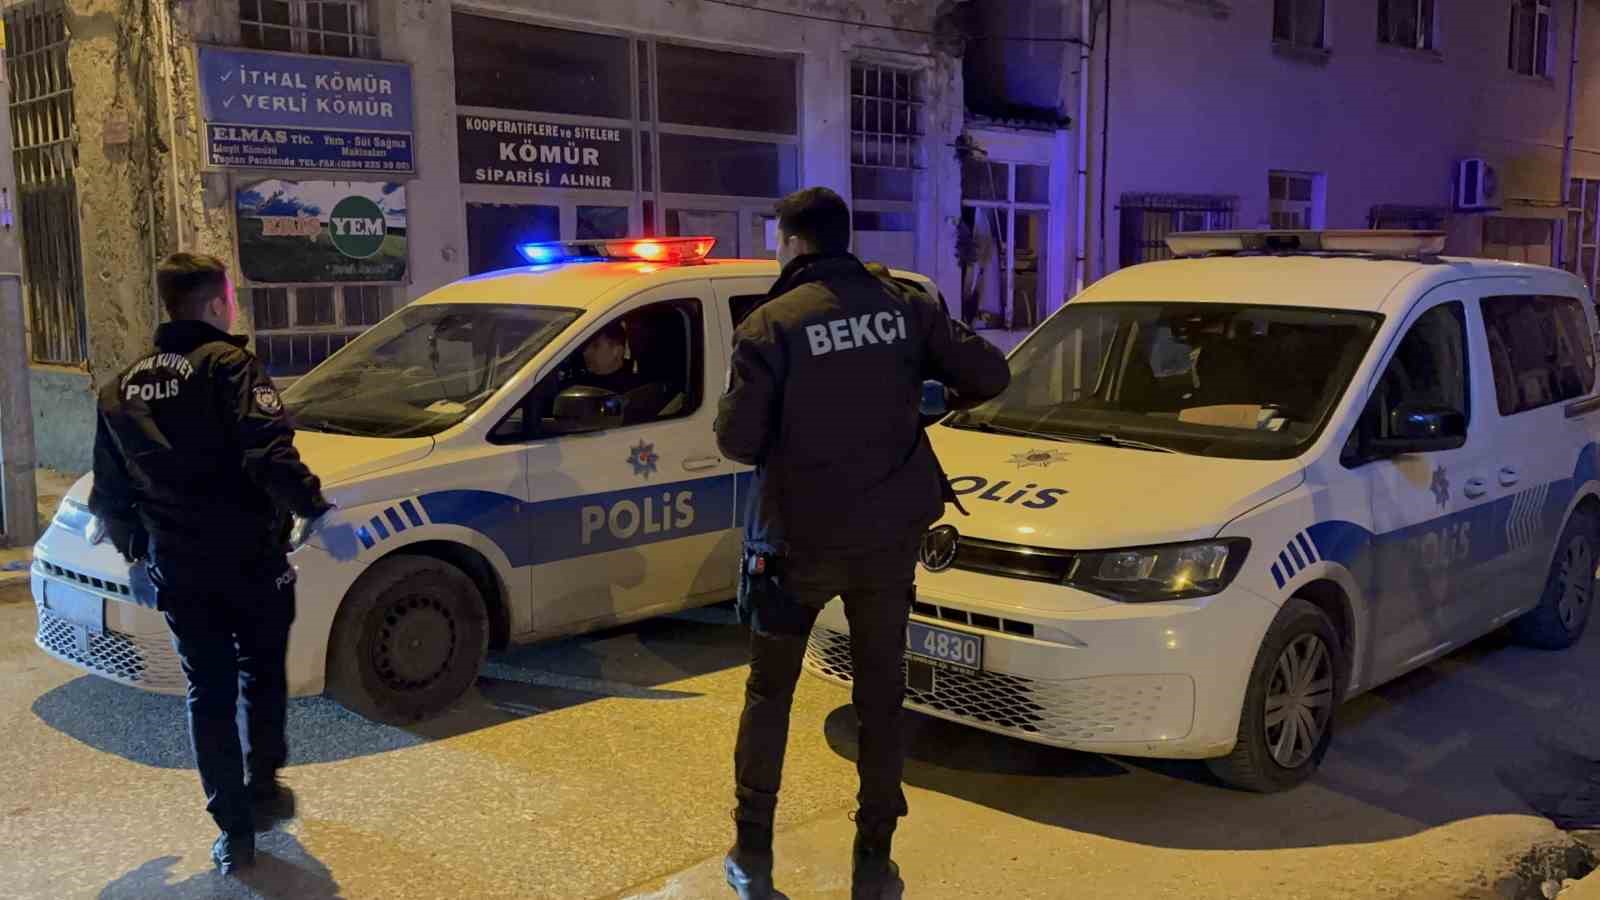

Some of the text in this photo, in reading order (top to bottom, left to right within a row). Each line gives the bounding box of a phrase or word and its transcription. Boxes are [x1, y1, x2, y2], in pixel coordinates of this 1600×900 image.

[240, 65, 392, 95] İTHAL KÖMÜR
[242, 93, 393, 118] YERLİ KÖMÜR
[213, 127, 288, 144] ELMAS
[500, 139, 600, 166] KÖMÜR
[475, 166, 612, 188] SİPARİŞİ ALINIR
[332, 217, 384, 236] YEM
[805, 310, 907, 356] BEKÇİ
[949, 475, 1069, 509] OLİS
[924, 629, 977, 664] 4830
